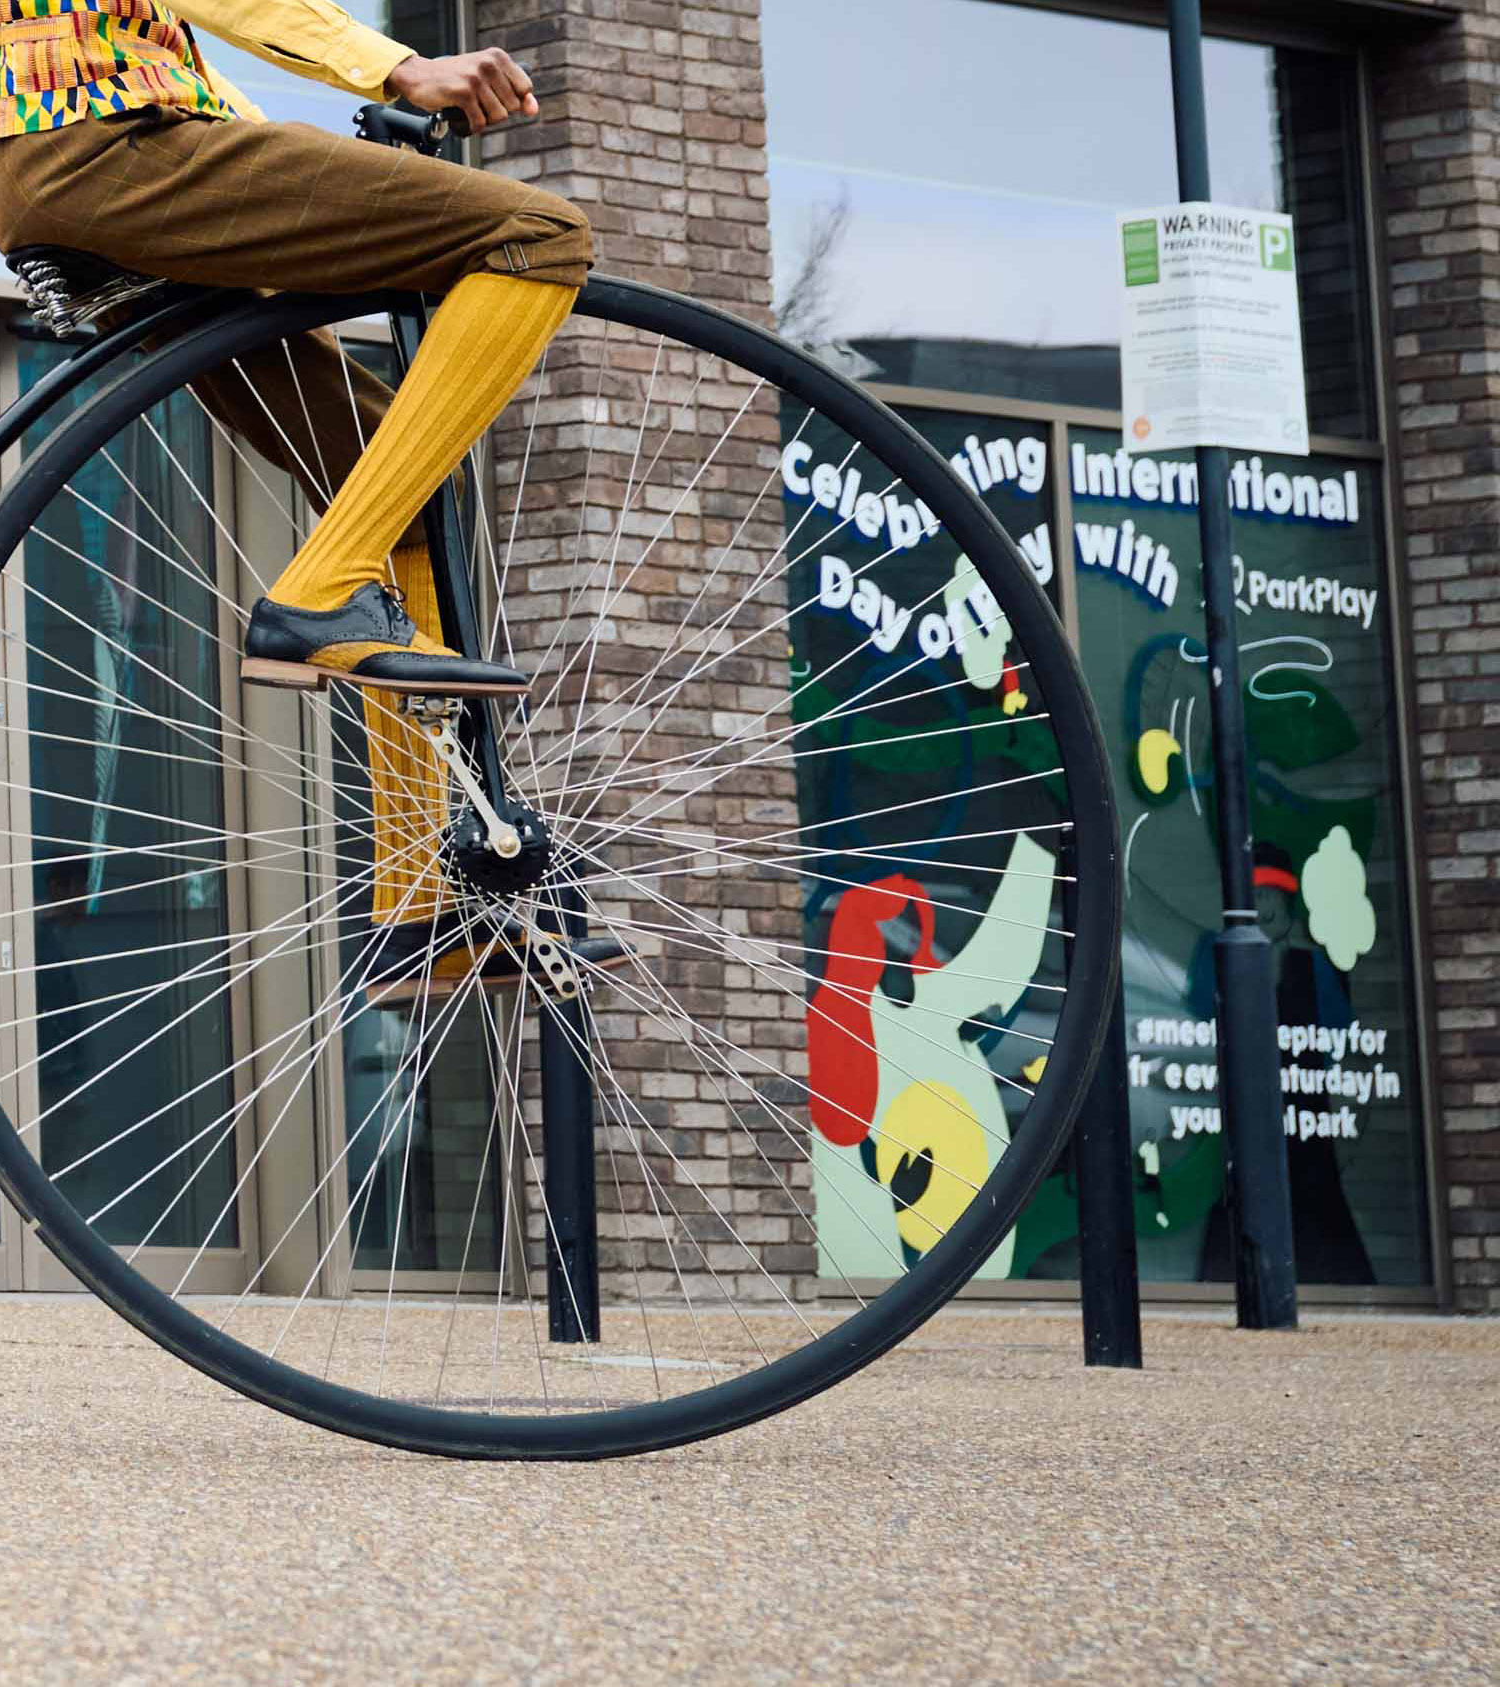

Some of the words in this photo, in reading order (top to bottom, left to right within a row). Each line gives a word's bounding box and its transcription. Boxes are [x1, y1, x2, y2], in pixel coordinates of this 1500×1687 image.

[1163, 214, 1253, 240] WARNING
[781, 434, 1047, 548] Celebting
[1071, 442, 1359, 523] Interntional
[820, 555, 912, 653] Day
[918, 597, 966, 659] of
[964, 522, 1053, 632] Py
[1075, 518, 1179, 607] with
[1248, 570, 1377, 630] ParkPlay
[1136, 1017, 1346, 1061] #meeeplay
[1348, 1019, 1387, 1056] for
[1280, 1063, 1373, 1105] turday
[1374, 1062, 1400, 1099] in
[1170, 1106, 1222, 1141] you
[1299, 1105, 1359, 1142] park
